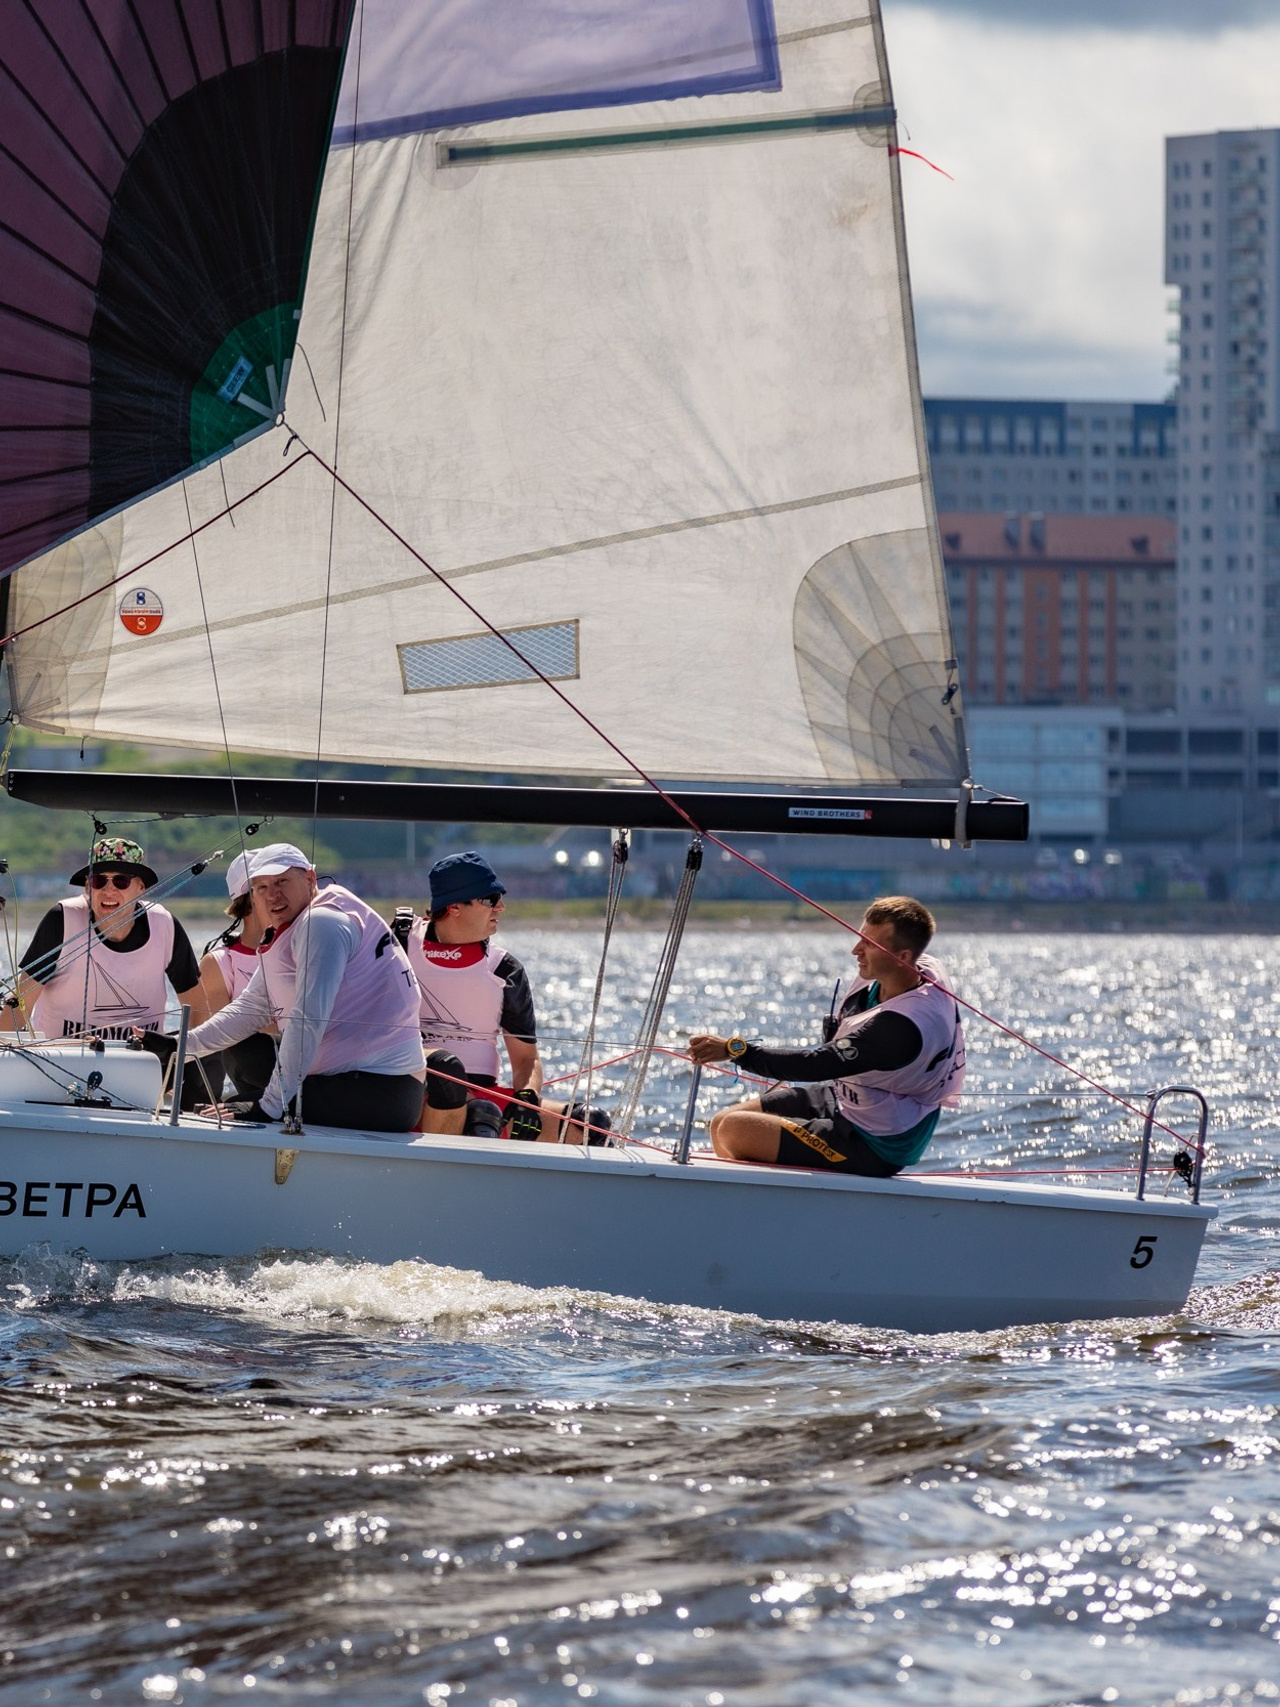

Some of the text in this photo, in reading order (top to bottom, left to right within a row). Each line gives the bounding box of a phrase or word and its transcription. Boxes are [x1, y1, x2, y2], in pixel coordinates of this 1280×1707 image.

[793, 809, 861, 819] WIND BROTHERS
[1129, 1235, 1159, 1270] 5
